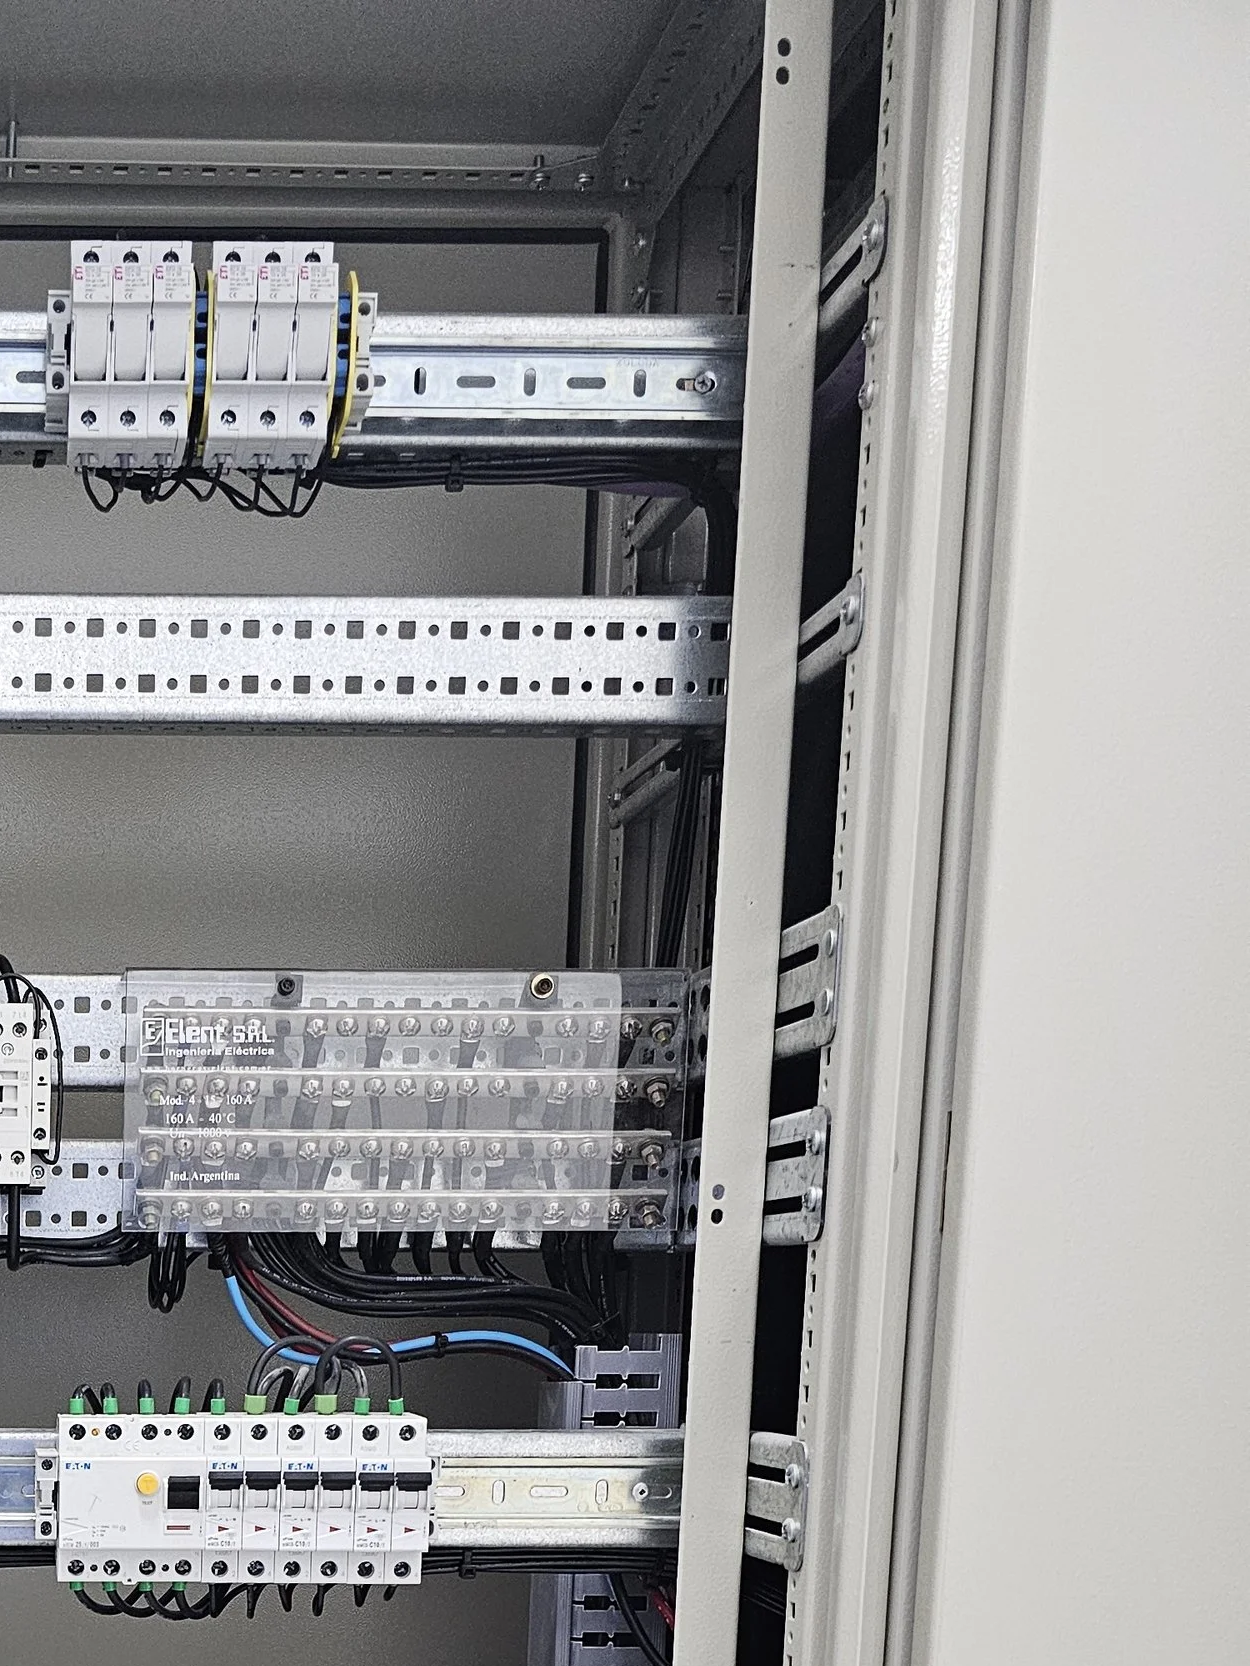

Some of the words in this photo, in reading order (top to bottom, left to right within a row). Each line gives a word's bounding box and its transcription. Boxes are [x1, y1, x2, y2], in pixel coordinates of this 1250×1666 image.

[165, 1018, 226, 1044] Elent
[224, 1046, 275, 1056] Eléctrica
[159, 1095, 184, 1105] Mod.
[188, 1095, 195, 1105] 4
[226, 1095, 243, 1105] 160
[244, 1095, 253, 1105] A
[165, 1113, 184, 1124] 160
[185, 1113, 194, 1124] A
[208, 1113, 222, 1124] 40
[169, 1171, 189, 1181] Ind.
[190, 1171, 240, 1184] Argentina
